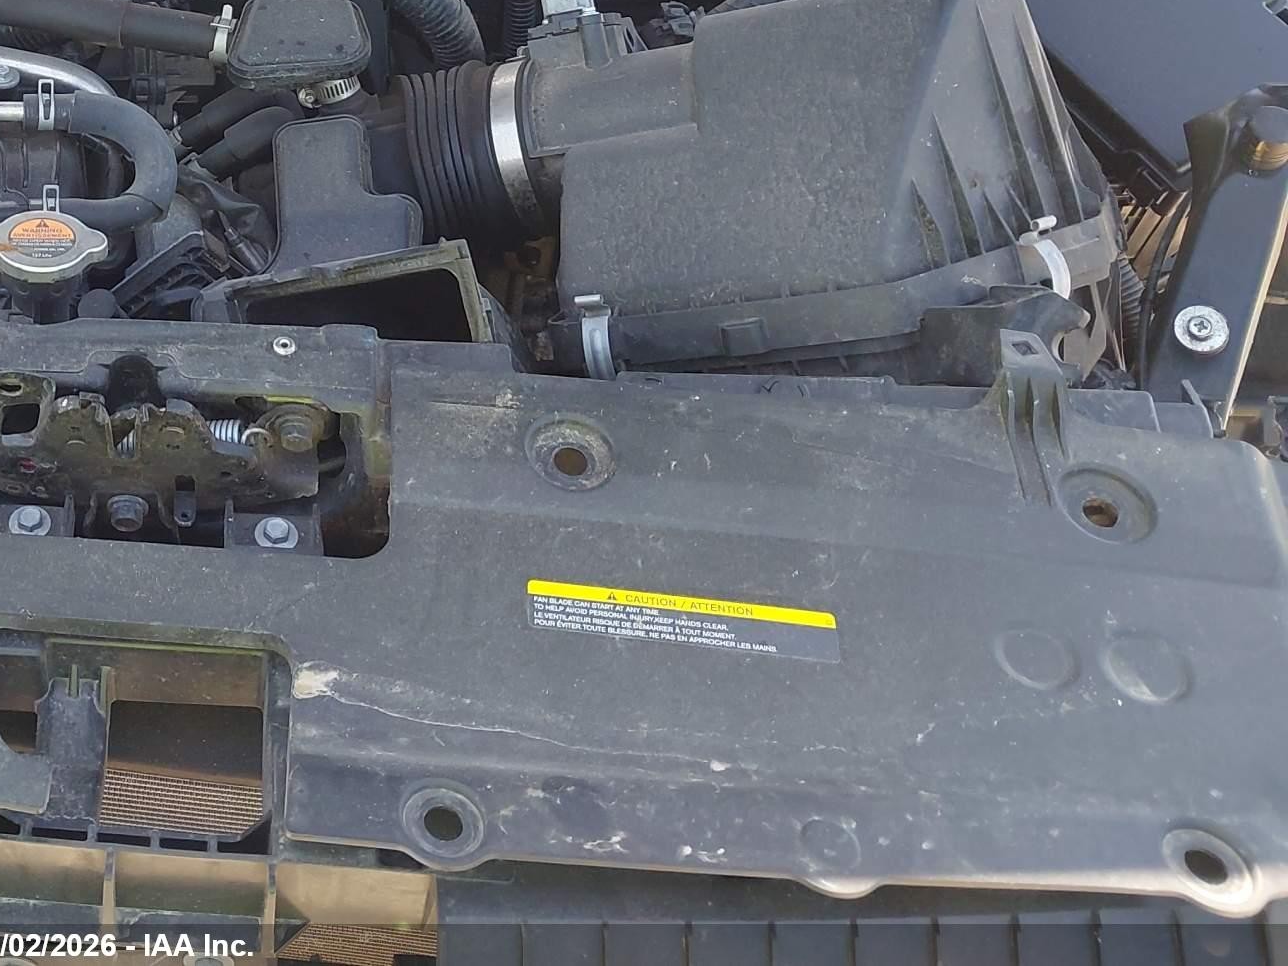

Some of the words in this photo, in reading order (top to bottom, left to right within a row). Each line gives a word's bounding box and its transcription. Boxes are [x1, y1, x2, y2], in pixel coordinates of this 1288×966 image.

[533, 595, 547, 603] FAN
[549, 596, 573, 607] BLADE
[574, 599, 591, 608] CAN
[591, 602, 614, 611] START
[615, 604, 625, 612] AT
[625, 605, 641, 614] ANY
[545, 604, 564, 613] HELP
[565, 606, 588, 616] AVOID
[589, 609, 628, 620] PERSONAL
[675, 618, 701, 628] HANDS
[702, 622, 729, 632] CLEAR.
[625, 594, 677, 608] CAUTION
[689, 601, 754, 616] ATTENTION
[534, 618, 556, 627] POUR
[582, 623, 606, 633] TOUTE
[649, 631, 660, 639] NE
[661, 633, 676, 641] PAS
[677, 634, 688, 642] EN
[689, 636, 736, 648] APPROCHER
[737, 641, 751, 649] LES
[544, 612, 591, 624] VENTILATEUR
[592, 618, 620, 628] RISQUE
[621, 621, 632, 629] DE
[681, 627, 701, 636] TOUT
[702, 631, 737, 641] MOMENT.
